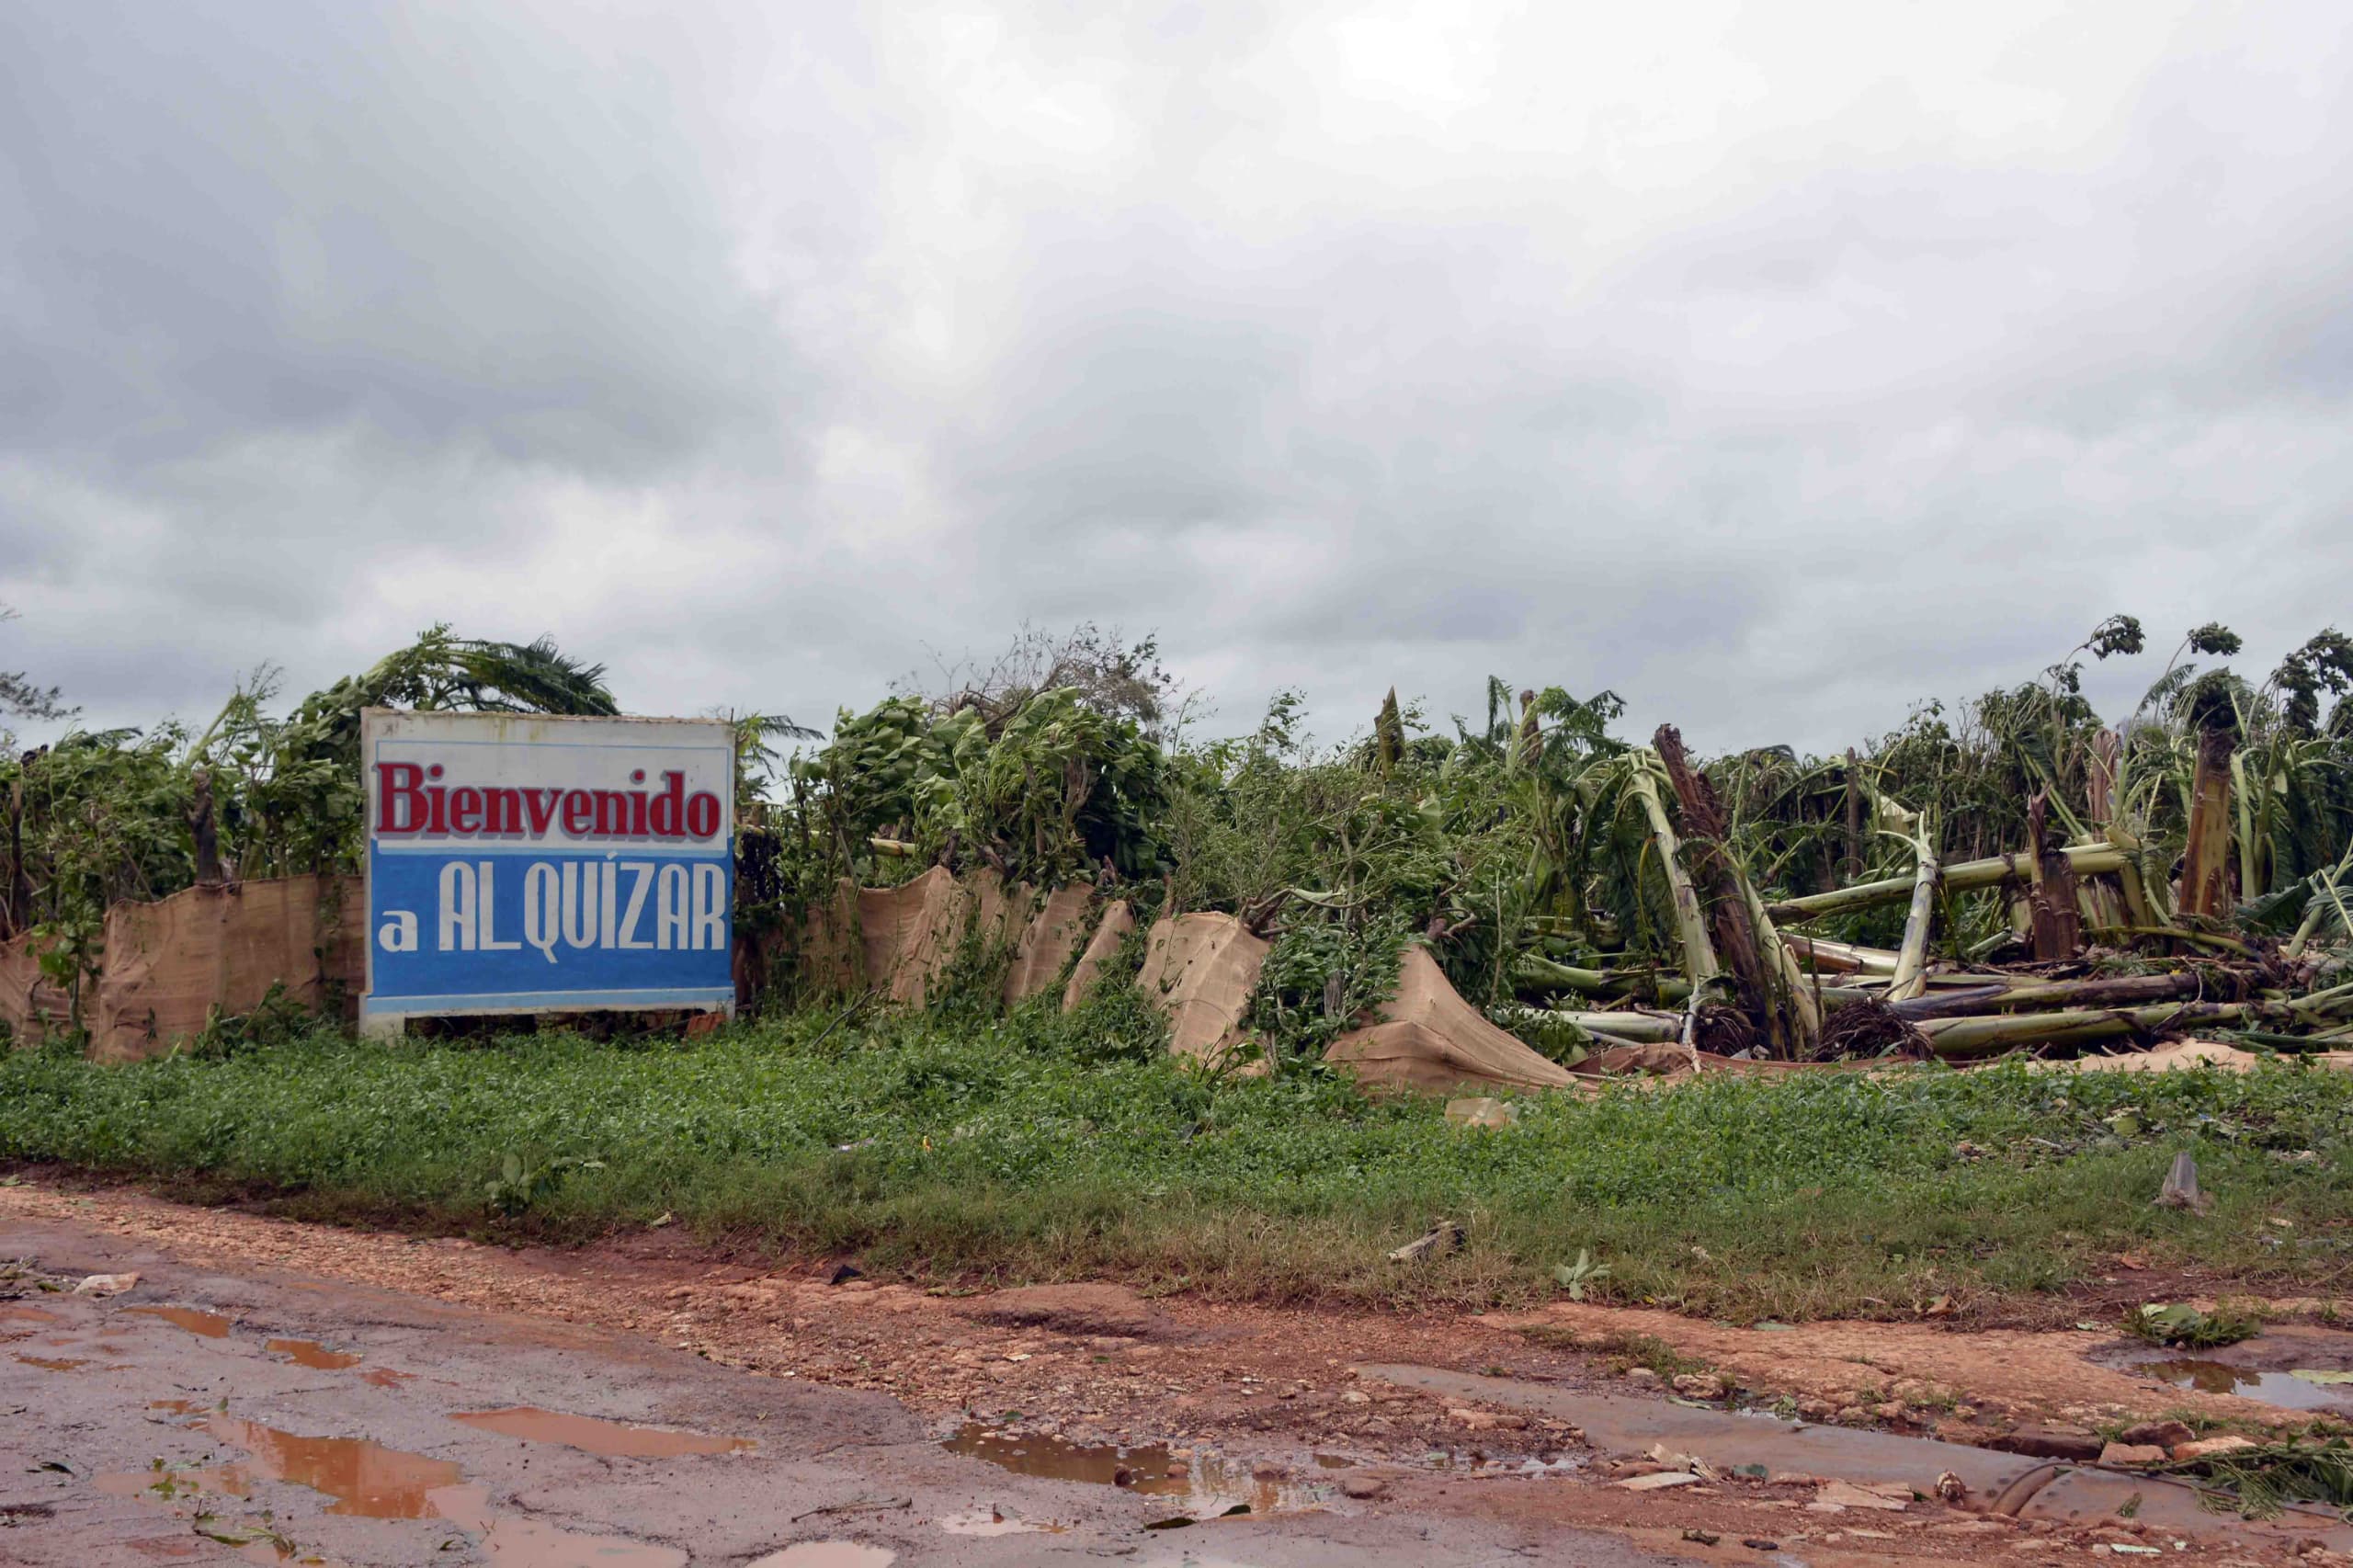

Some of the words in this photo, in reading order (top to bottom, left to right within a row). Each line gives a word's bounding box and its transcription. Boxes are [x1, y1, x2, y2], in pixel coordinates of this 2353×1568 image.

[373, 761, 722, 840] Bienvenido
[378, 910, 418, 952] a
[438, 851, 726, 964] ALQUÍZAR
